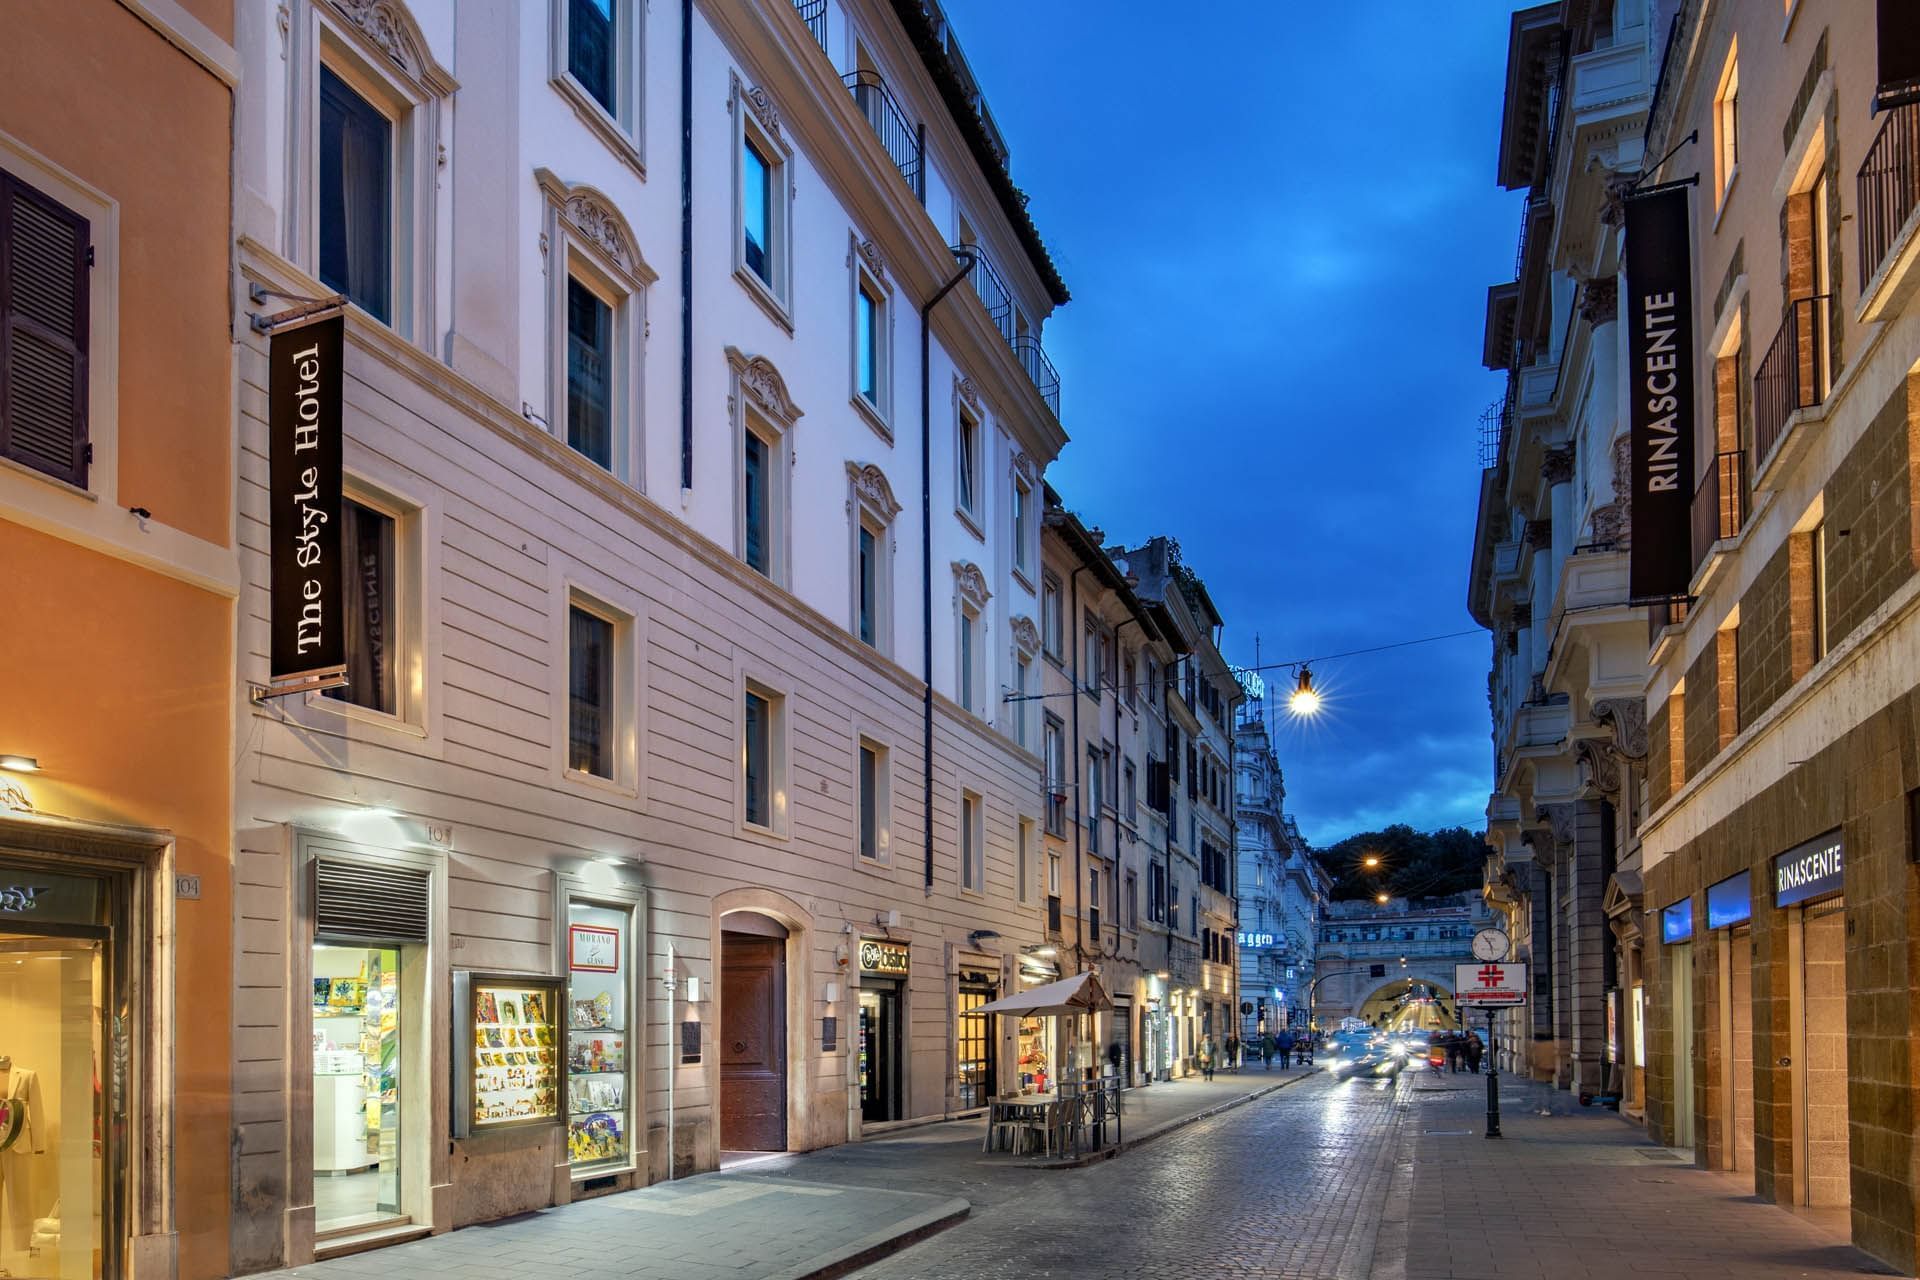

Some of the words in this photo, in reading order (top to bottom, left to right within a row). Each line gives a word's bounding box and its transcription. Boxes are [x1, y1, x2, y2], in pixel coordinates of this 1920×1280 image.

[293, 342, 320, 456] Hotel
[1645, 291, 1679, 492] RINASCENTE
[294, 466, 328, 568] Style
[297, 579, 322, 655] The
[176, 878, 198, 895] 104
[1778, 844, 1841, 893] RINASCENTE
